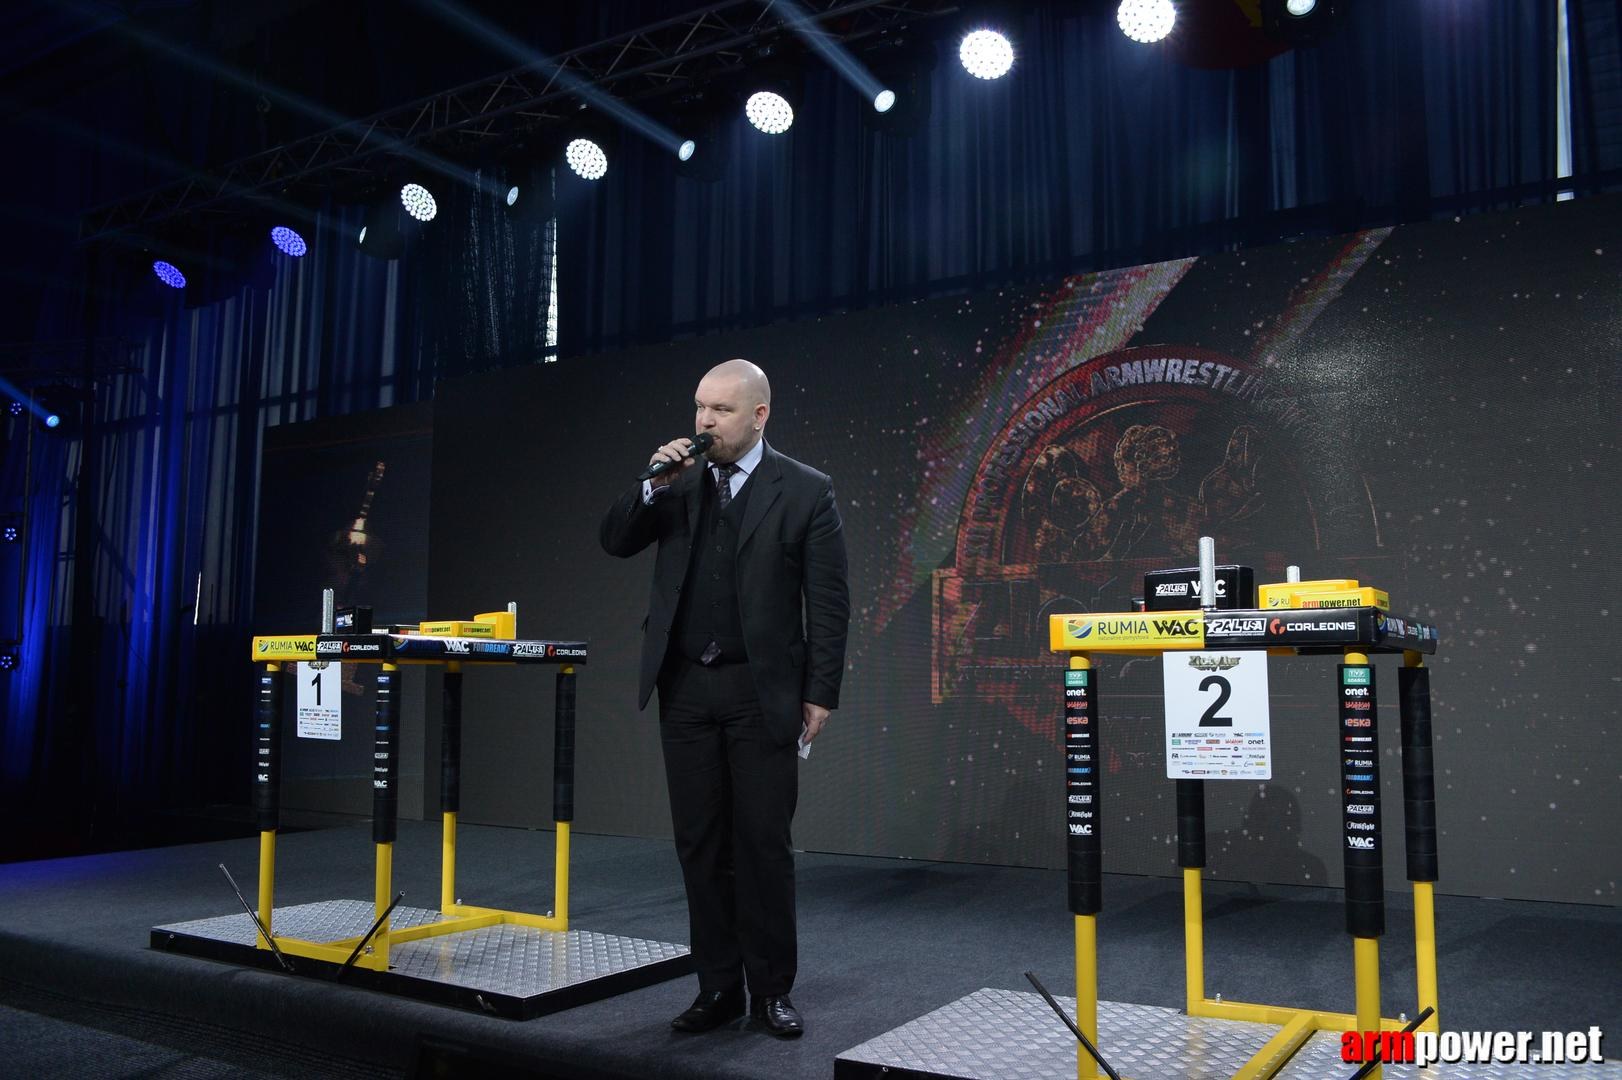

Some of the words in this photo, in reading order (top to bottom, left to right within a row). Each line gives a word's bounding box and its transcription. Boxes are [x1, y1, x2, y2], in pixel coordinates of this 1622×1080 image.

[1091, 358, 1268, 401] ARMWRESTLIN
[1191, 580, 1226, 595] WC
[1302, 598, 1361, 608] armpower.net
[1098, 621, 1149, 635] RUMIA
[1152, 619, 1199, 636] WAC
[1286, 622, 1356, 631] CORLEONIS
[270, 641, 293, 650] RUMIA
[294, 641, 314, 652] WAC
[443, 640, 470, 652] WAC
[311, 672, 322, 706] 1
[1198, 675, 1233, 727] 2
[1069, 823, 1092, 834] WAC
[1347, 836, 1375, 848] WAC
